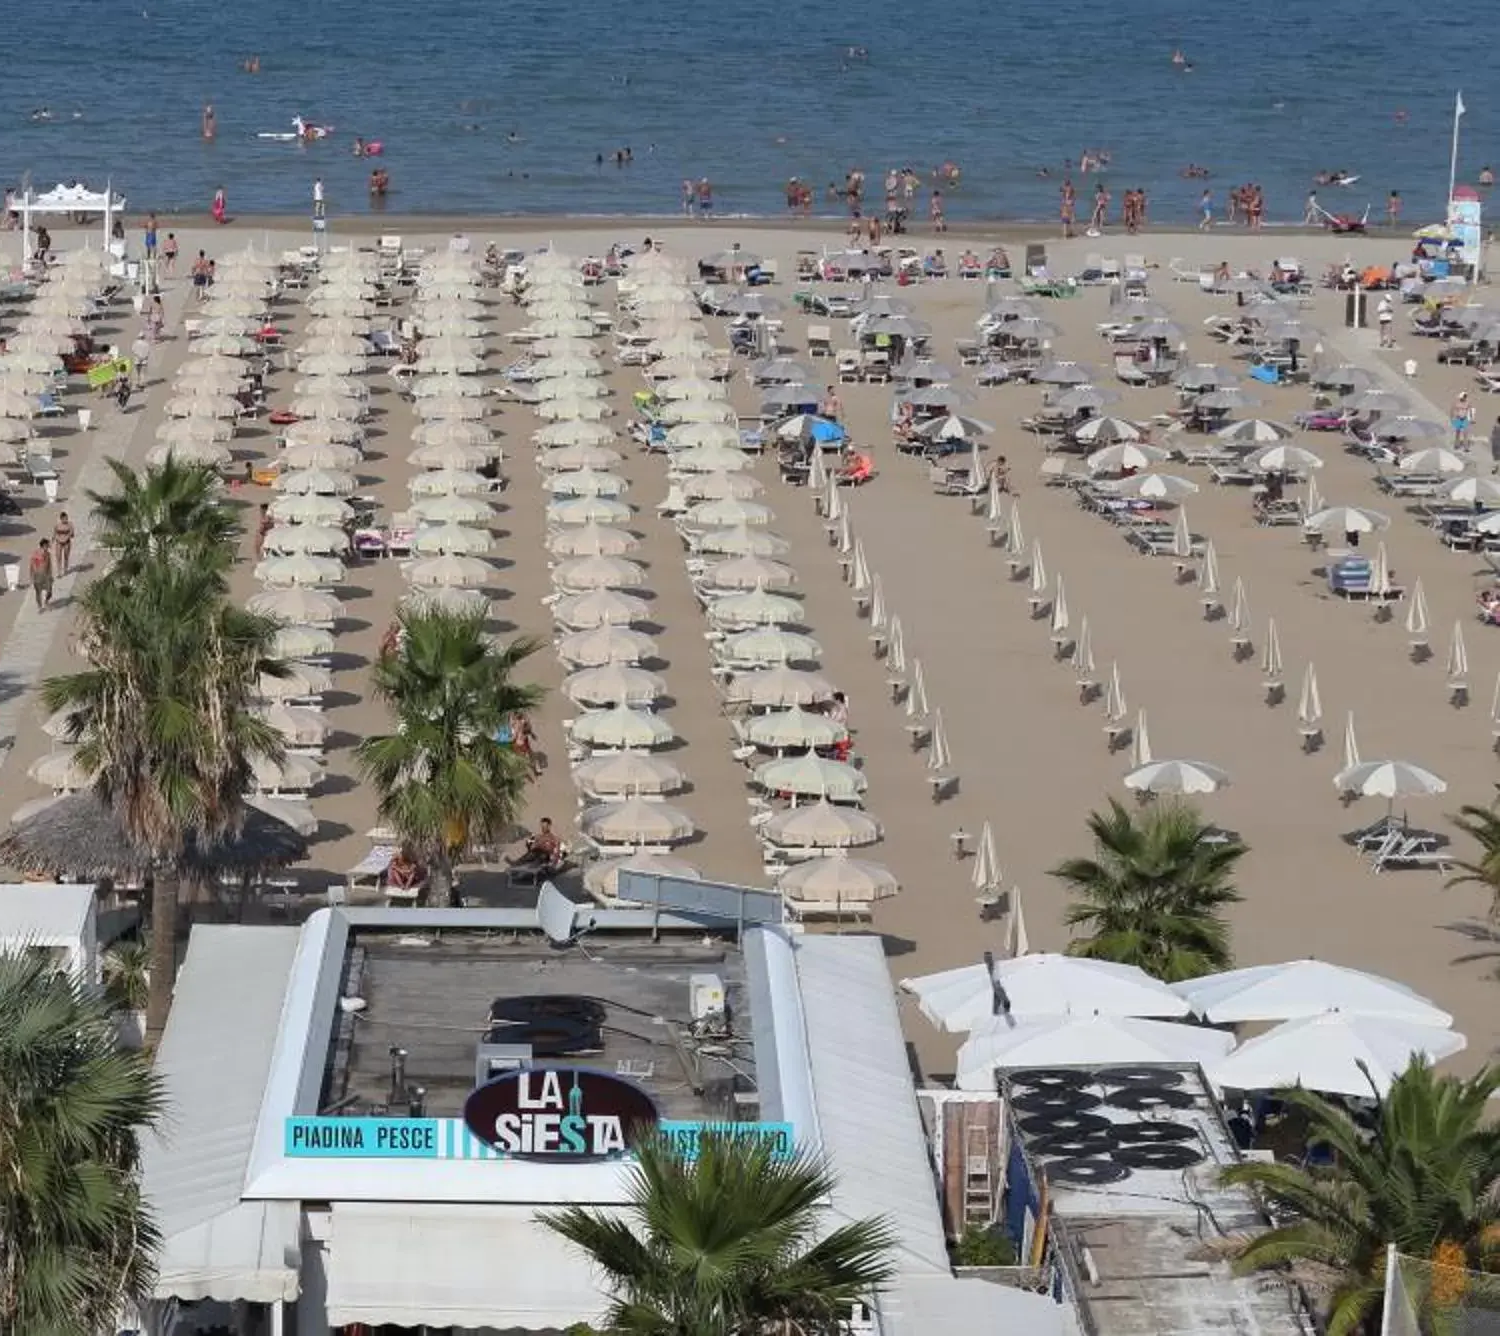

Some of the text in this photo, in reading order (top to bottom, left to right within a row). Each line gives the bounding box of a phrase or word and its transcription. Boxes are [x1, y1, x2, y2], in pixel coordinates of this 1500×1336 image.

[517, 1071, 563, 1109] LA
[293, 1125, 433, 1149] PIADINA PESCE
